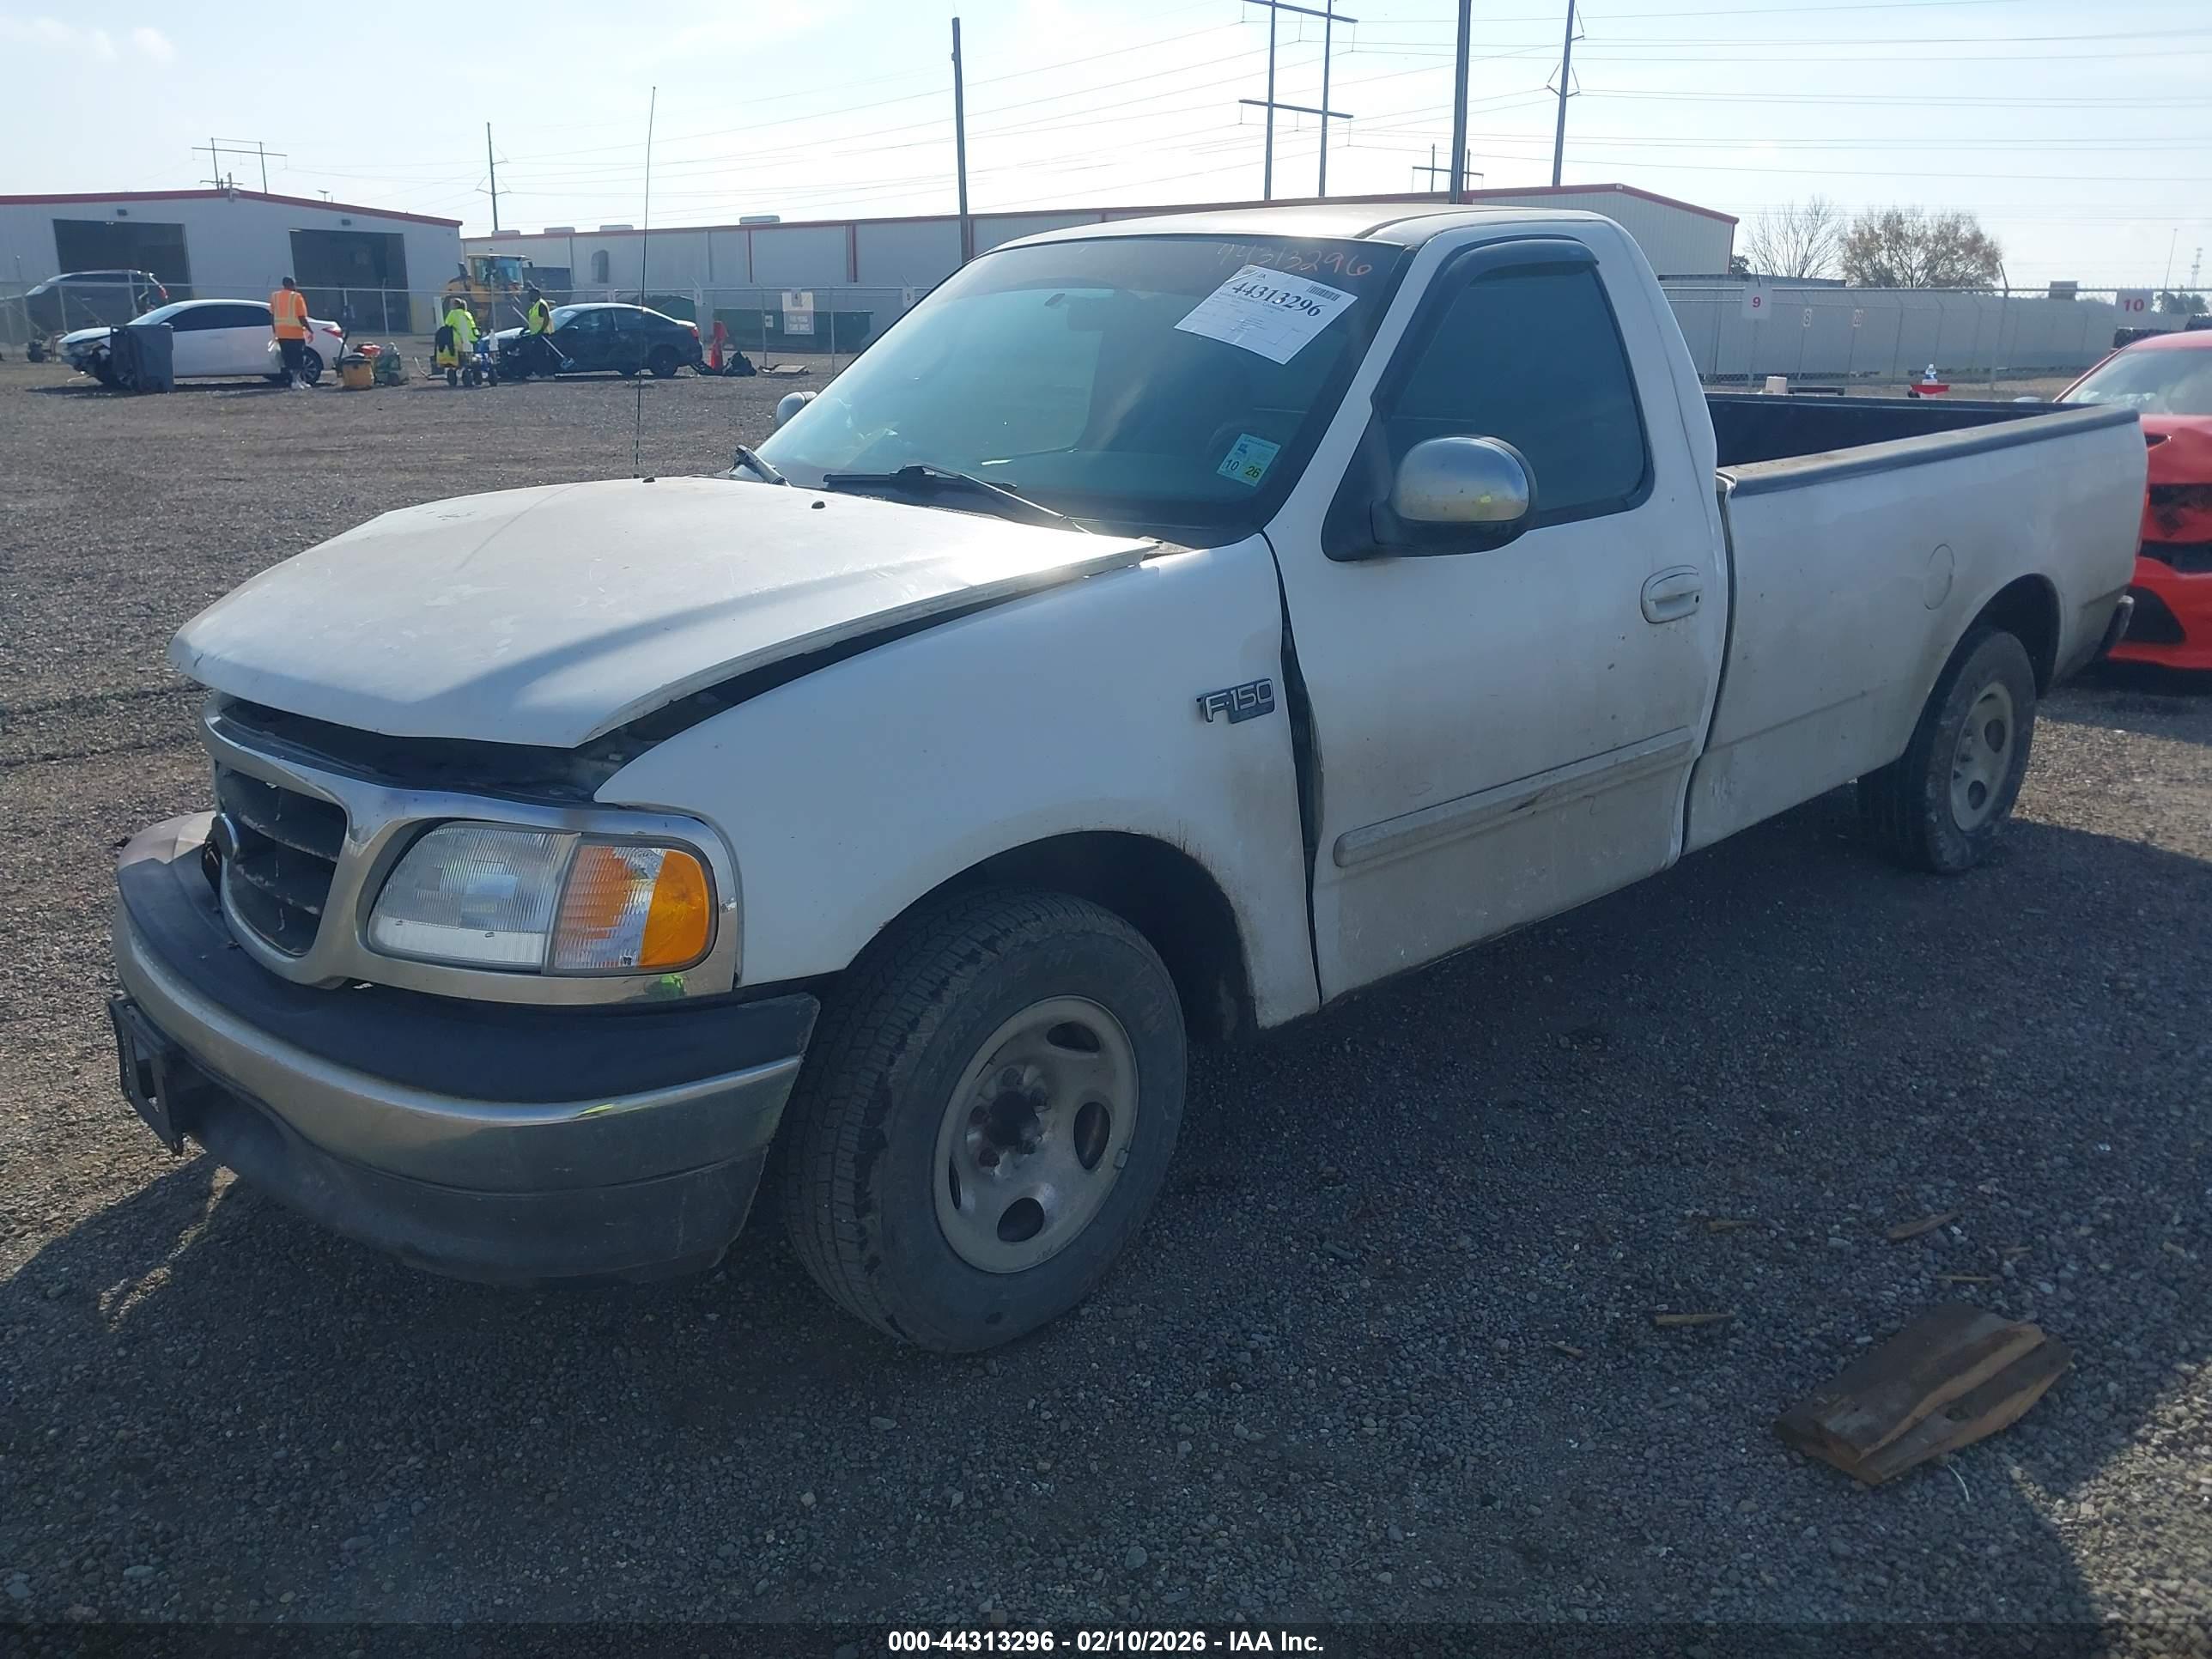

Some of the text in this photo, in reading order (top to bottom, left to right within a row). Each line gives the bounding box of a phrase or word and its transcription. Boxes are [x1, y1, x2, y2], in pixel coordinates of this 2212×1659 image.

[1231, 282, 1328, 317] 44313296
[1753, 297, 1761, 308] 9
[2124, 299, 2145, 312] 10
[1225, 459, 1239, 471] 10
[1245, 466, 1261, 478] 26
